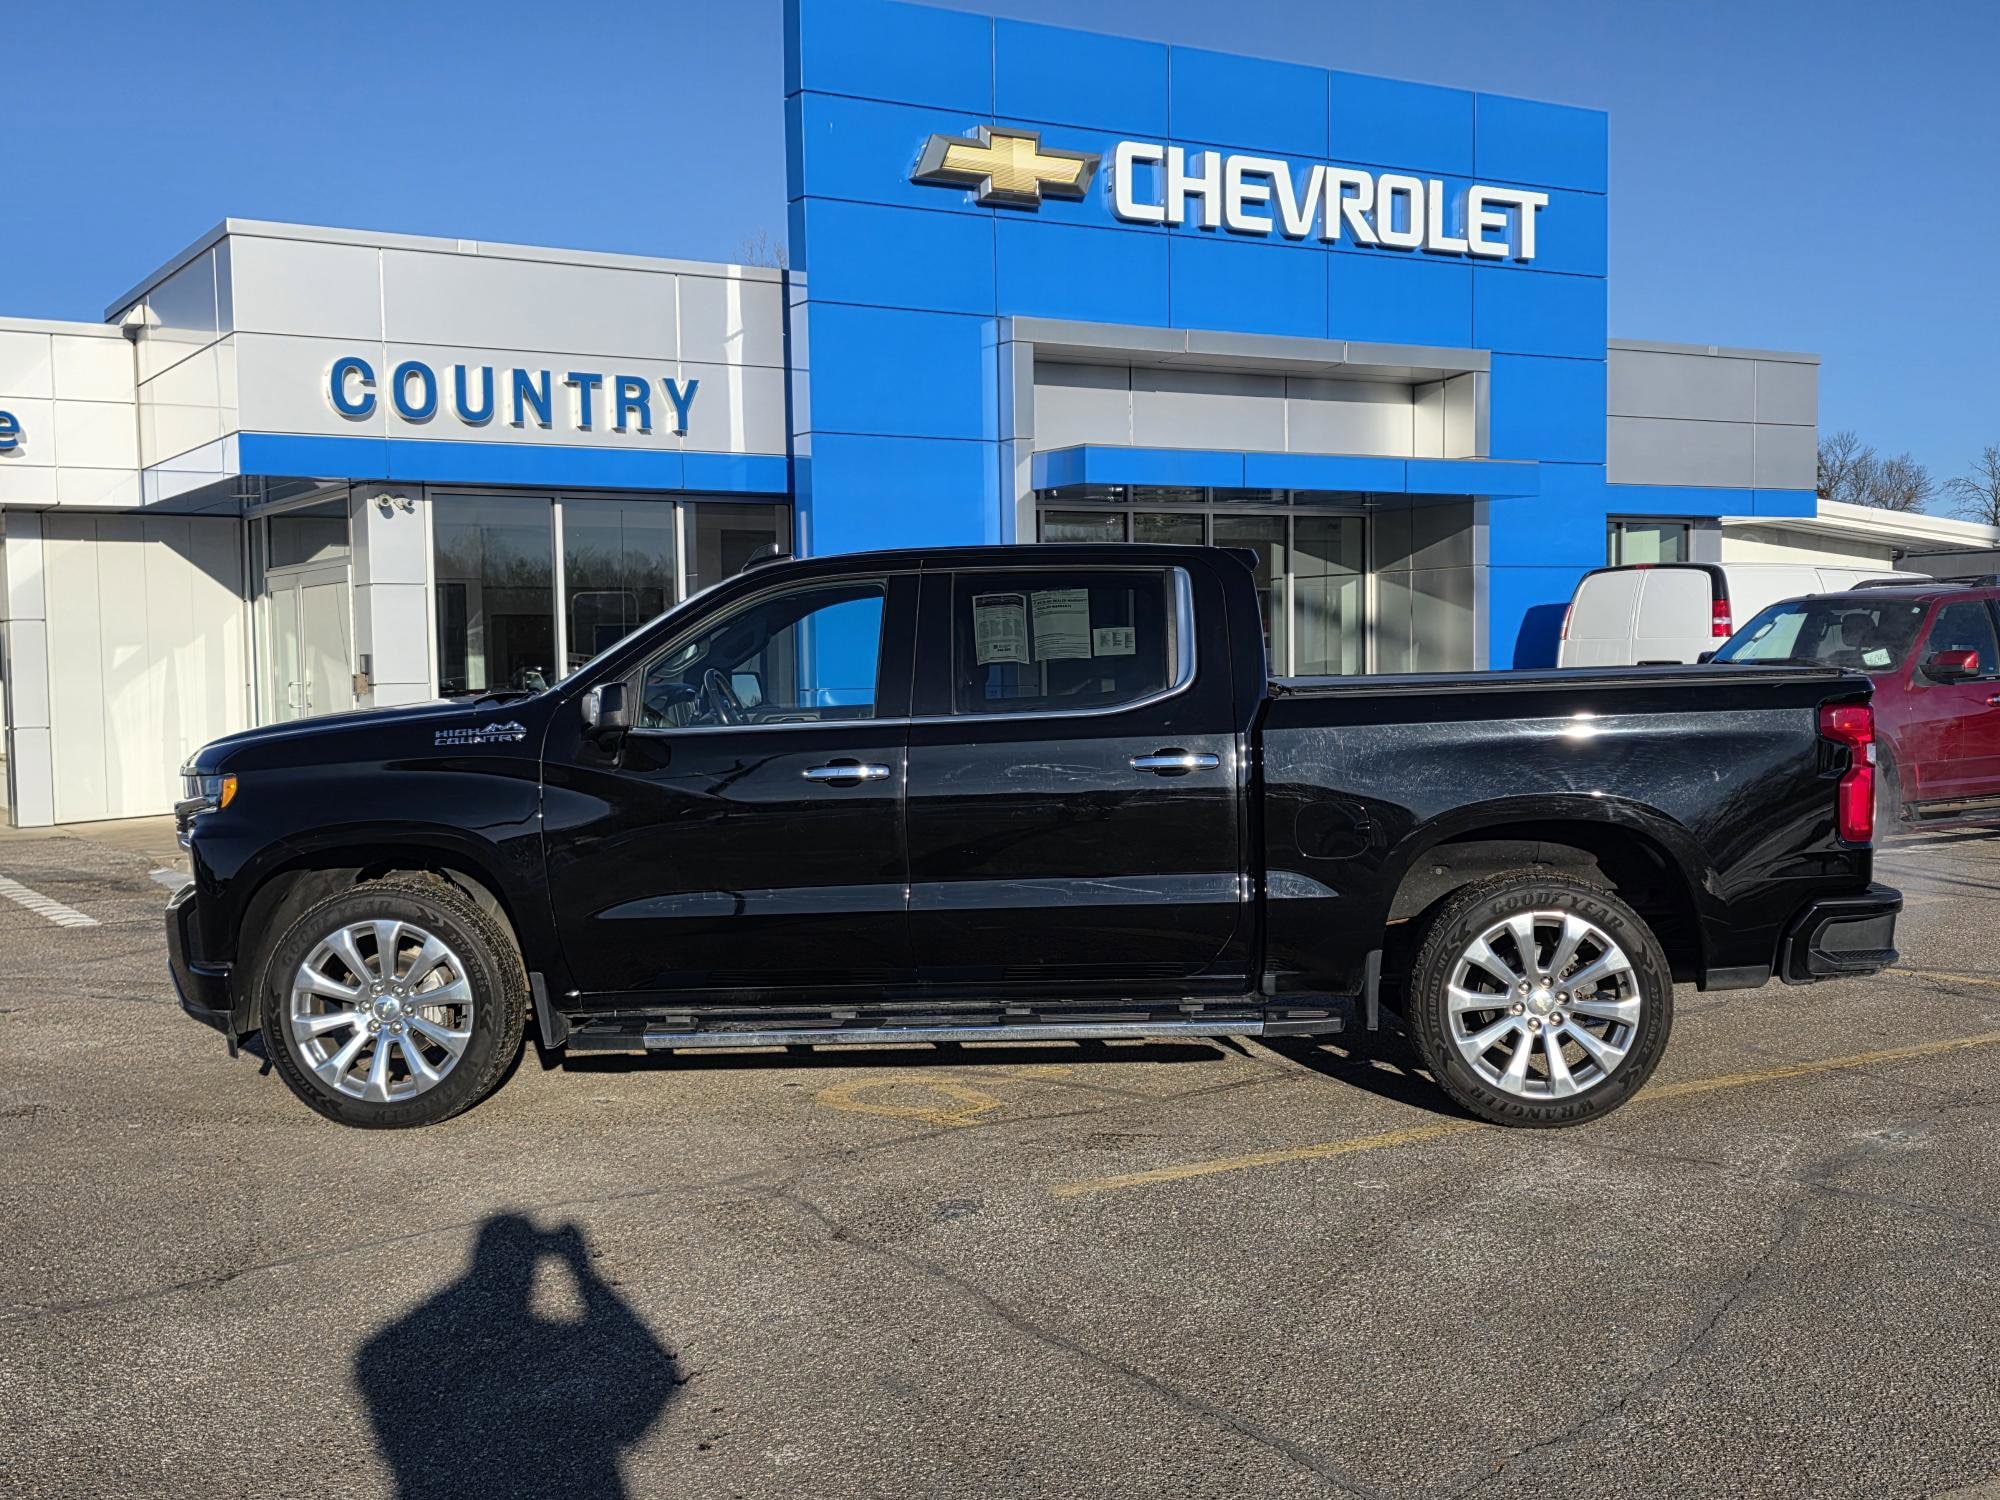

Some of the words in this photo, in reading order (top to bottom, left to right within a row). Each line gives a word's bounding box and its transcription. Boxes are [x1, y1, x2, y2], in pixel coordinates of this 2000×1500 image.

[1113, 140, 1549, 260] CHEVROLET
[328, 356, 700, 436] COUNTRY
[434, 734, 526, 746] COUNTRY
[435, 727, 480, 738] HIGH
